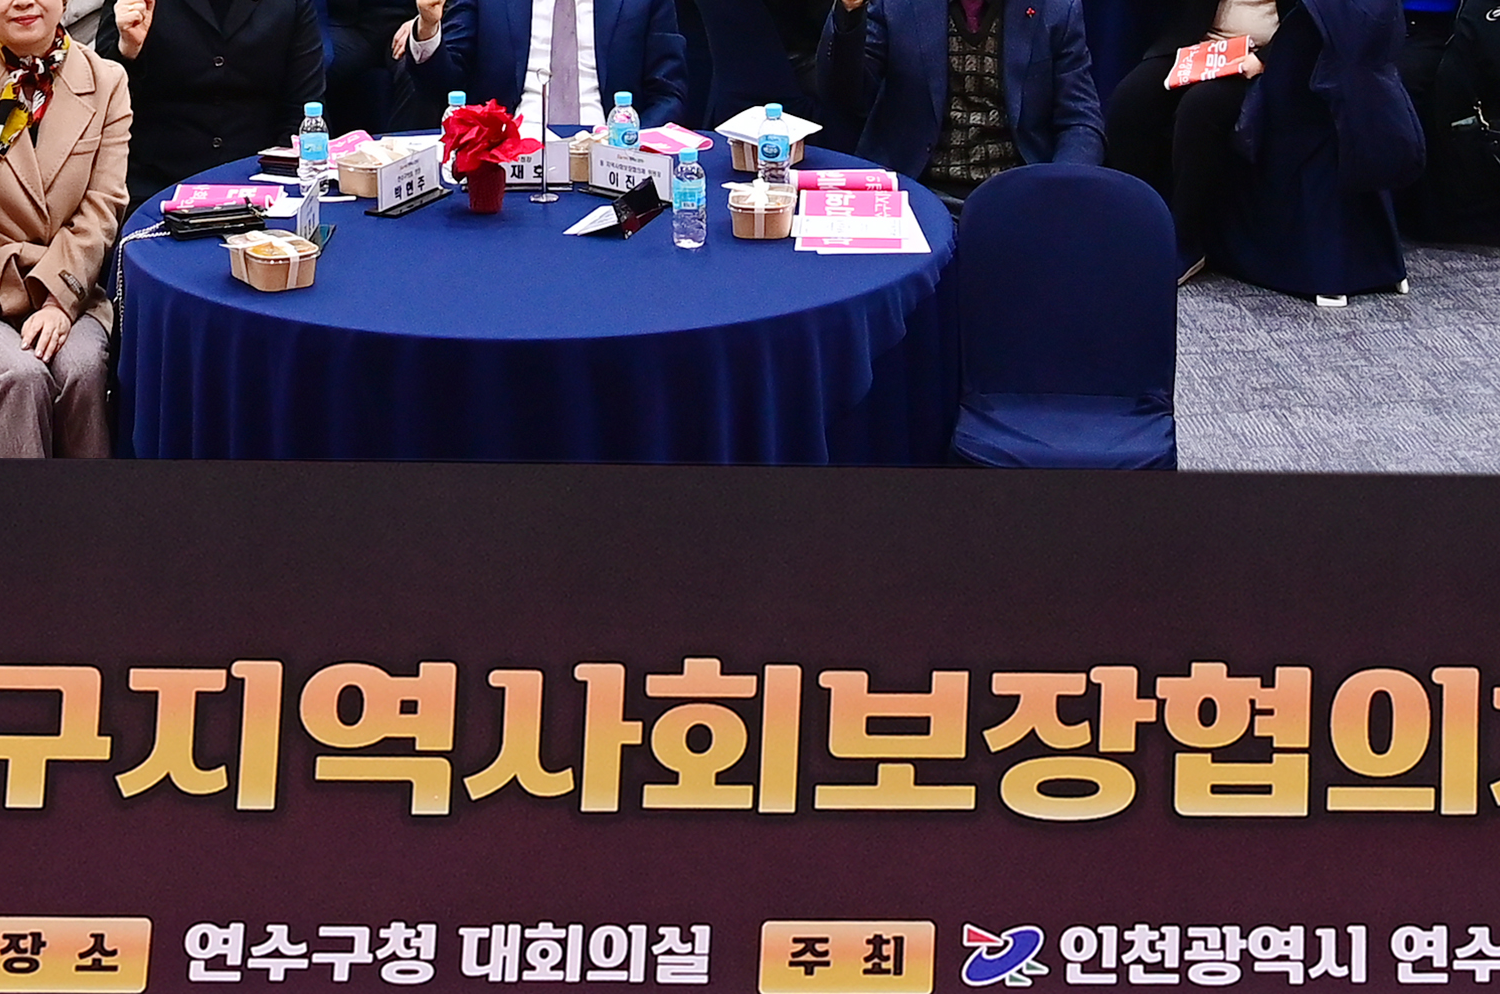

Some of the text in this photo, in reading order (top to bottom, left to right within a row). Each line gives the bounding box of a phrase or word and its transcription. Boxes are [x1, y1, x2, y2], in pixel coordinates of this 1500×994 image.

[185, 921, 437, 985] 연수구청
[458, 922, 712, 985] 대회의실
[1059, 924, 1368, 986] 인천광역시
